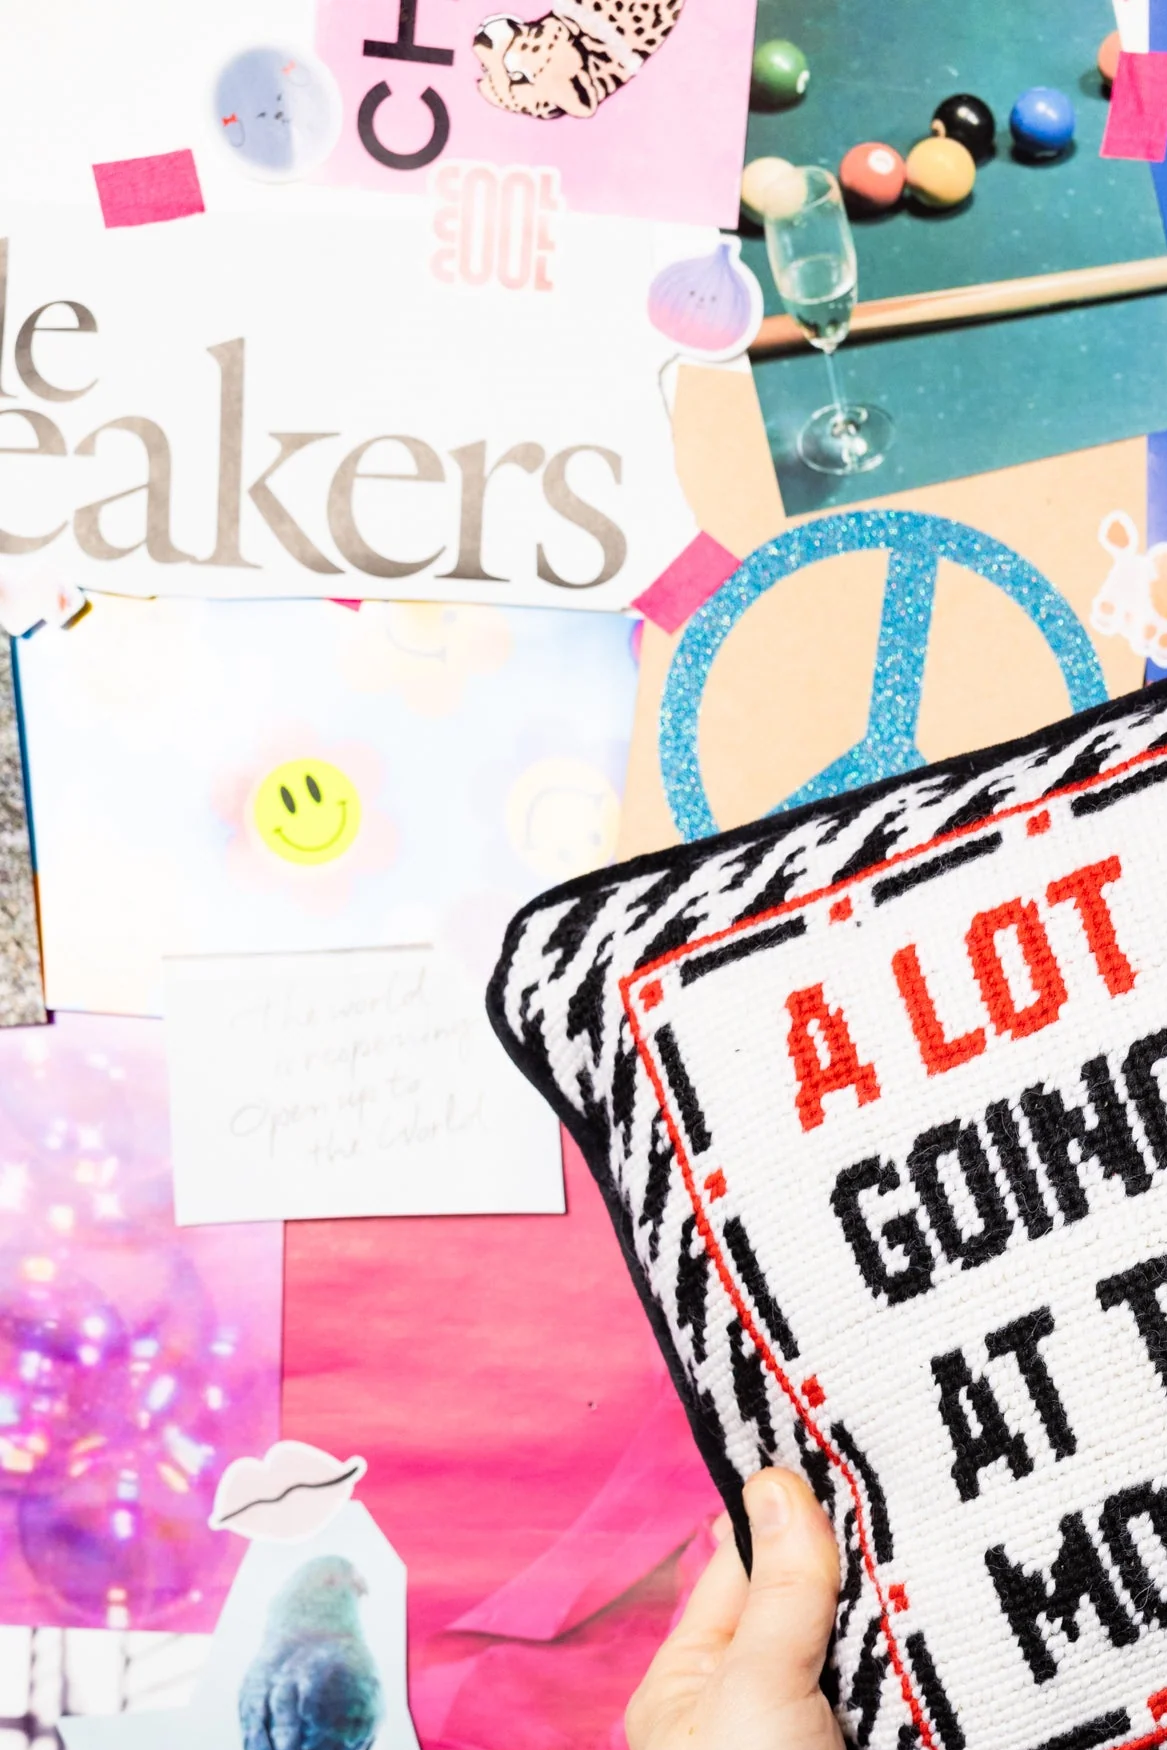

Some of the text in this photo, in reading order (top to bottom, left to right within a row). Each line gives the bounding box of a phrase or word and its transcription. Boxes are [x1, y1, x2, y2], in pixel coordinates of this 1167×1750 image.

[785, 856, 1138, 1132] A LOT
[931, 1306, 1078, 1501] AT
